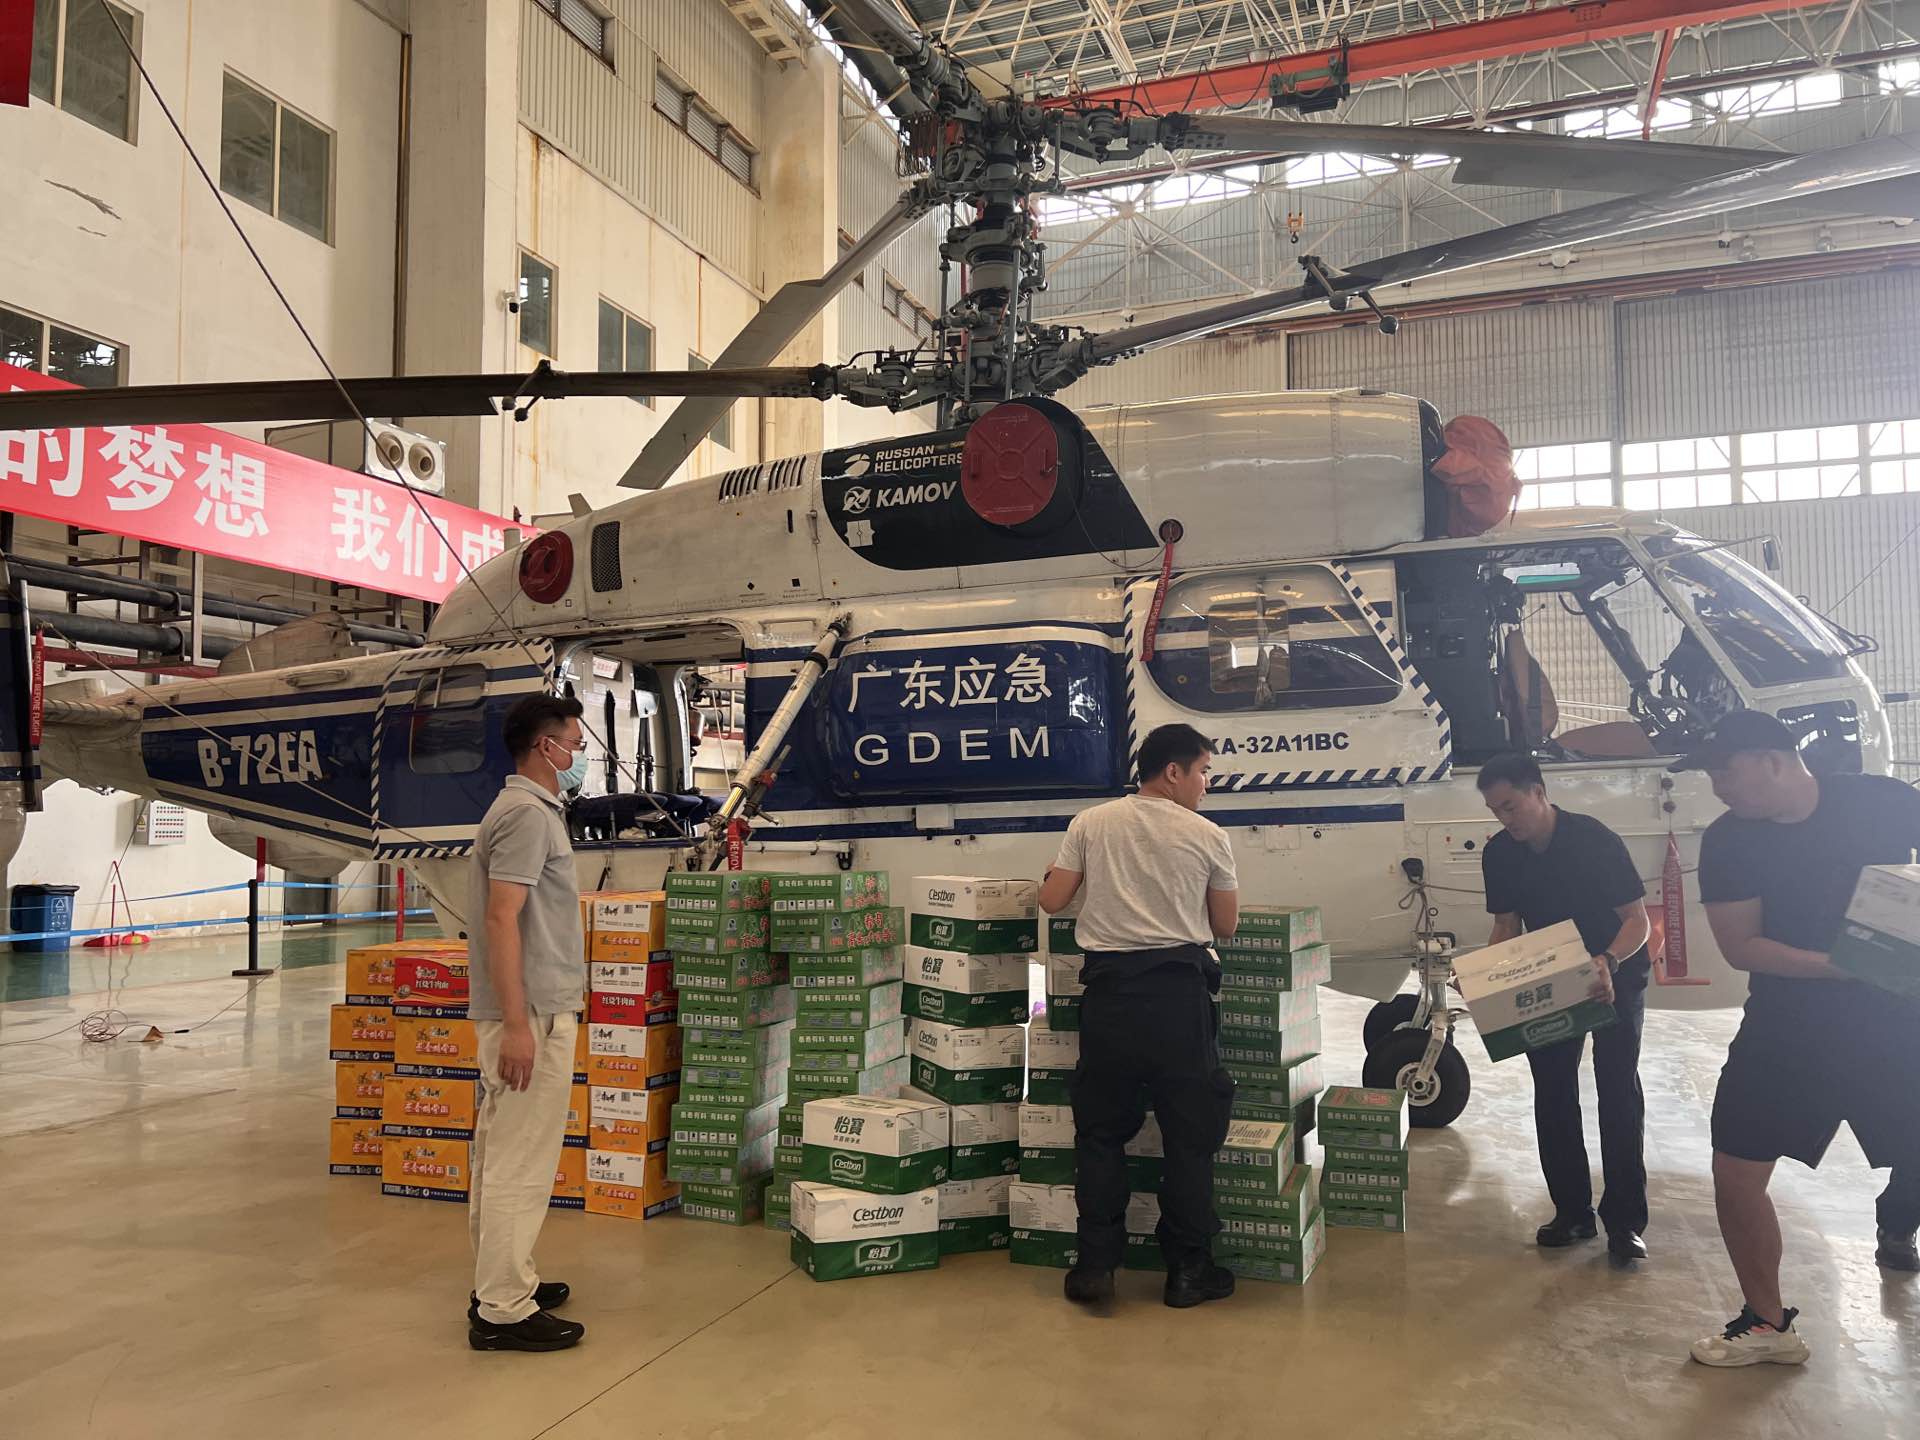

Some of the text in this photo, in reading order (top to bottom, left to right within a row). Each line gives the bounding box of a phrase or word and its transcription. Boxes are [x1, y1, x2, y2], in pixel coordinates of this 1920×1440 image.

[874, 452, 963, 473] HELICOPTERS
[876, 445, 935, 461] RUSSIAN
[876, 481, 957, 508] KAMOV
[331, 487, 533, 584] 我们成
[848, 653, 1052, 712] 广东应急
[32, 684, 42, 711] BEFORE
[31, 712, 41, 737] FLIGHT
[197, 730, 322, 787] B-72EA
[834, 1115, 865, 1136] 怡寶
[853, 1206, 904, 1221] C'estbon
